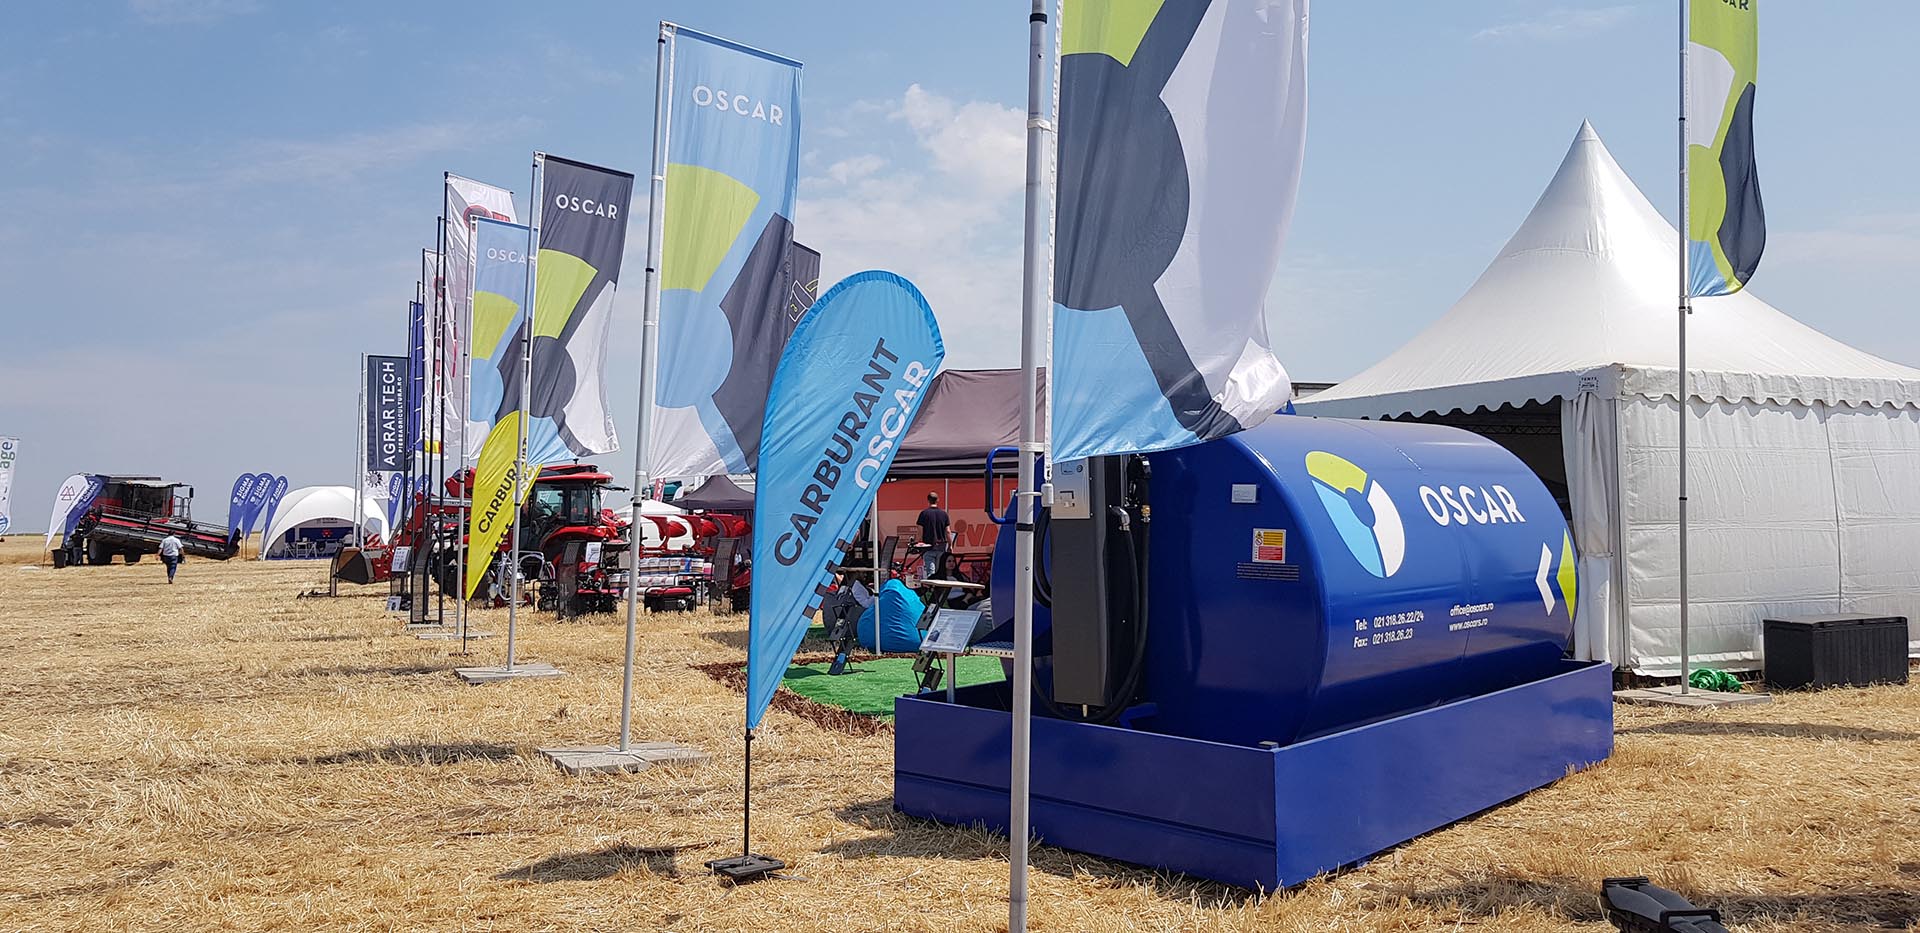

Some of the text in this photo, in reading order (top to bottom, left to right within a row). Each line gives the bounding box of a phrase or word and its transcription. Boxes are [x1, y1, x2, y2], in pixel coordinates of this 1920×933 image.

[692, 85, 784, 127] OSCAR
[555, 194, 618, 220] OSCAR
[487, 247, 537, 265] OSCA
[382, 362, 396, 466] AGRAR TECH
[854, 360, 931, 490] OSCAR
[774, 337, 899, 567] CARBURANT
[236, 477, 250, 497] SIGMA
[1418, 484, 1526, 527] OSCAR
[1449, 602, 1494, 617] office@oscars.ro
[1355, 619, 1368, 631] Tel:
[1449, 618, 1489, 632] www.oscars.ro
[1353, 636, 1368, 648] Fax:
